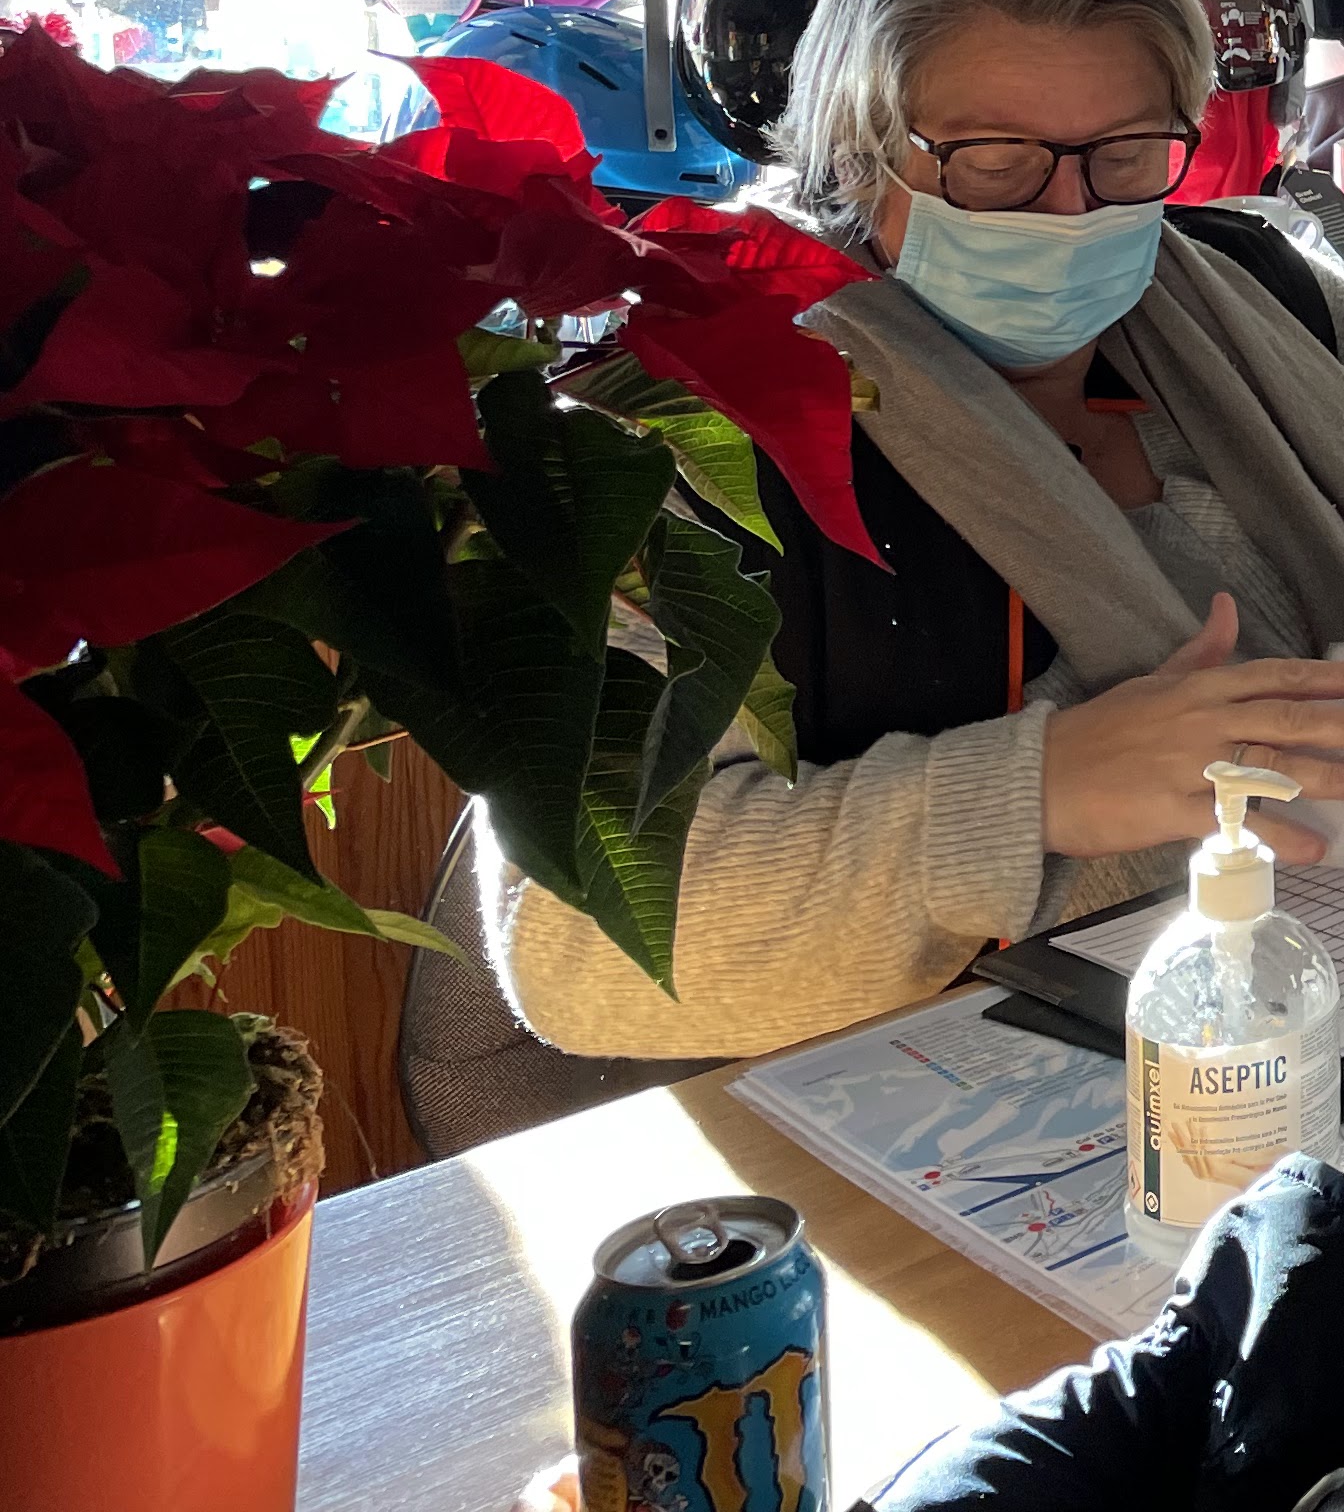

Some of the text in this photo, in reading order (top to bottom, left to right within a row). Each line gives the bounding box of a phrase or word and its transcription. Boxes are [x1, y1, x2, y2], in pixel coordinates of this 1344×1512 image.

[1189, 1055, 1287, 1096] ASEPTIC
[1145, 1060, 1161, 1151] quimxel
[700, 1280, 777, 1322] MANGO
